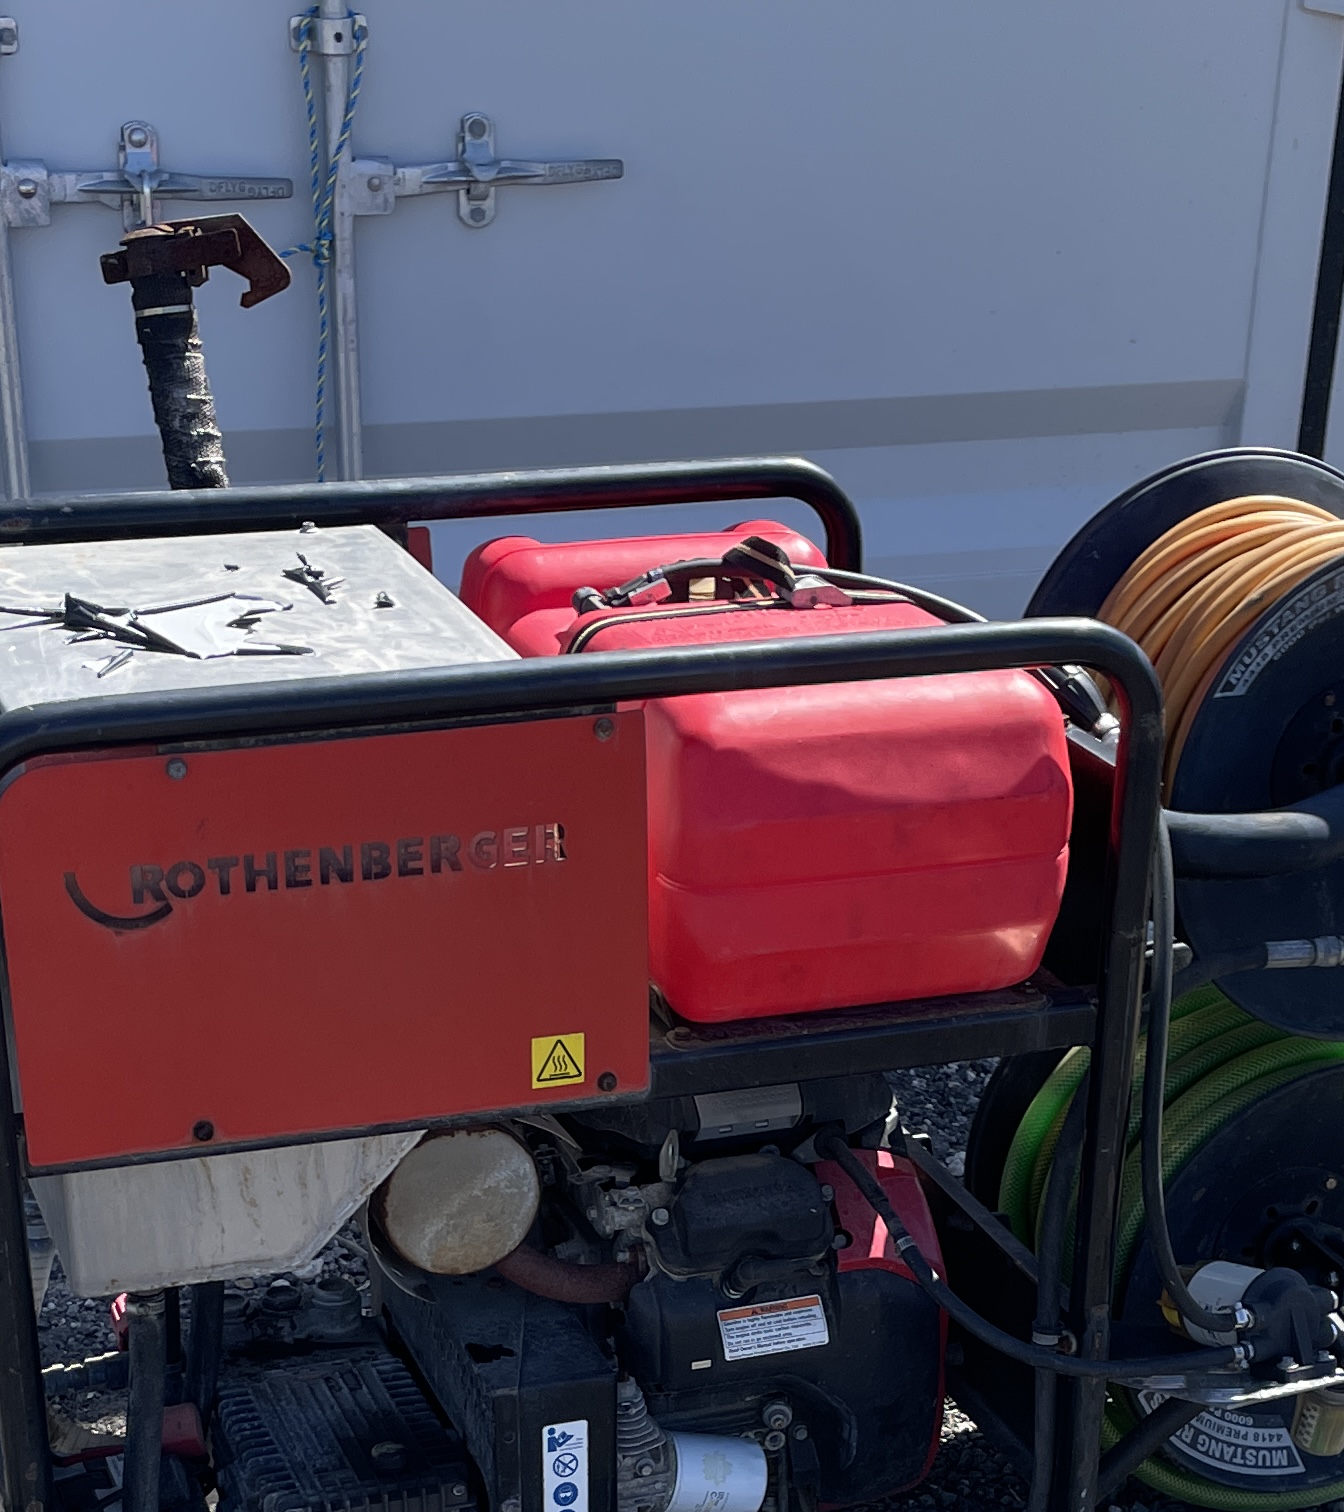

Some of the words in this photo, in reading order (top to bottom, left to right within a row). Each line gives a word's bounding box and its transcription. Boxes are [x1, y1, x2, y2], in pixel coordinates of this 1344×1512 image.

[1227, 583, 1328, 686] MUSTANG
[130, 822, 569, 905] ROTHENBERGER
[1196, 1415, 1249, 1440] PREMIUM
[1225, 1413, 1253, 1426] 6000
[1197, 1433, 1289, 1466] MUSTANG
[1253, 1432, 1283, 1443] 4418
